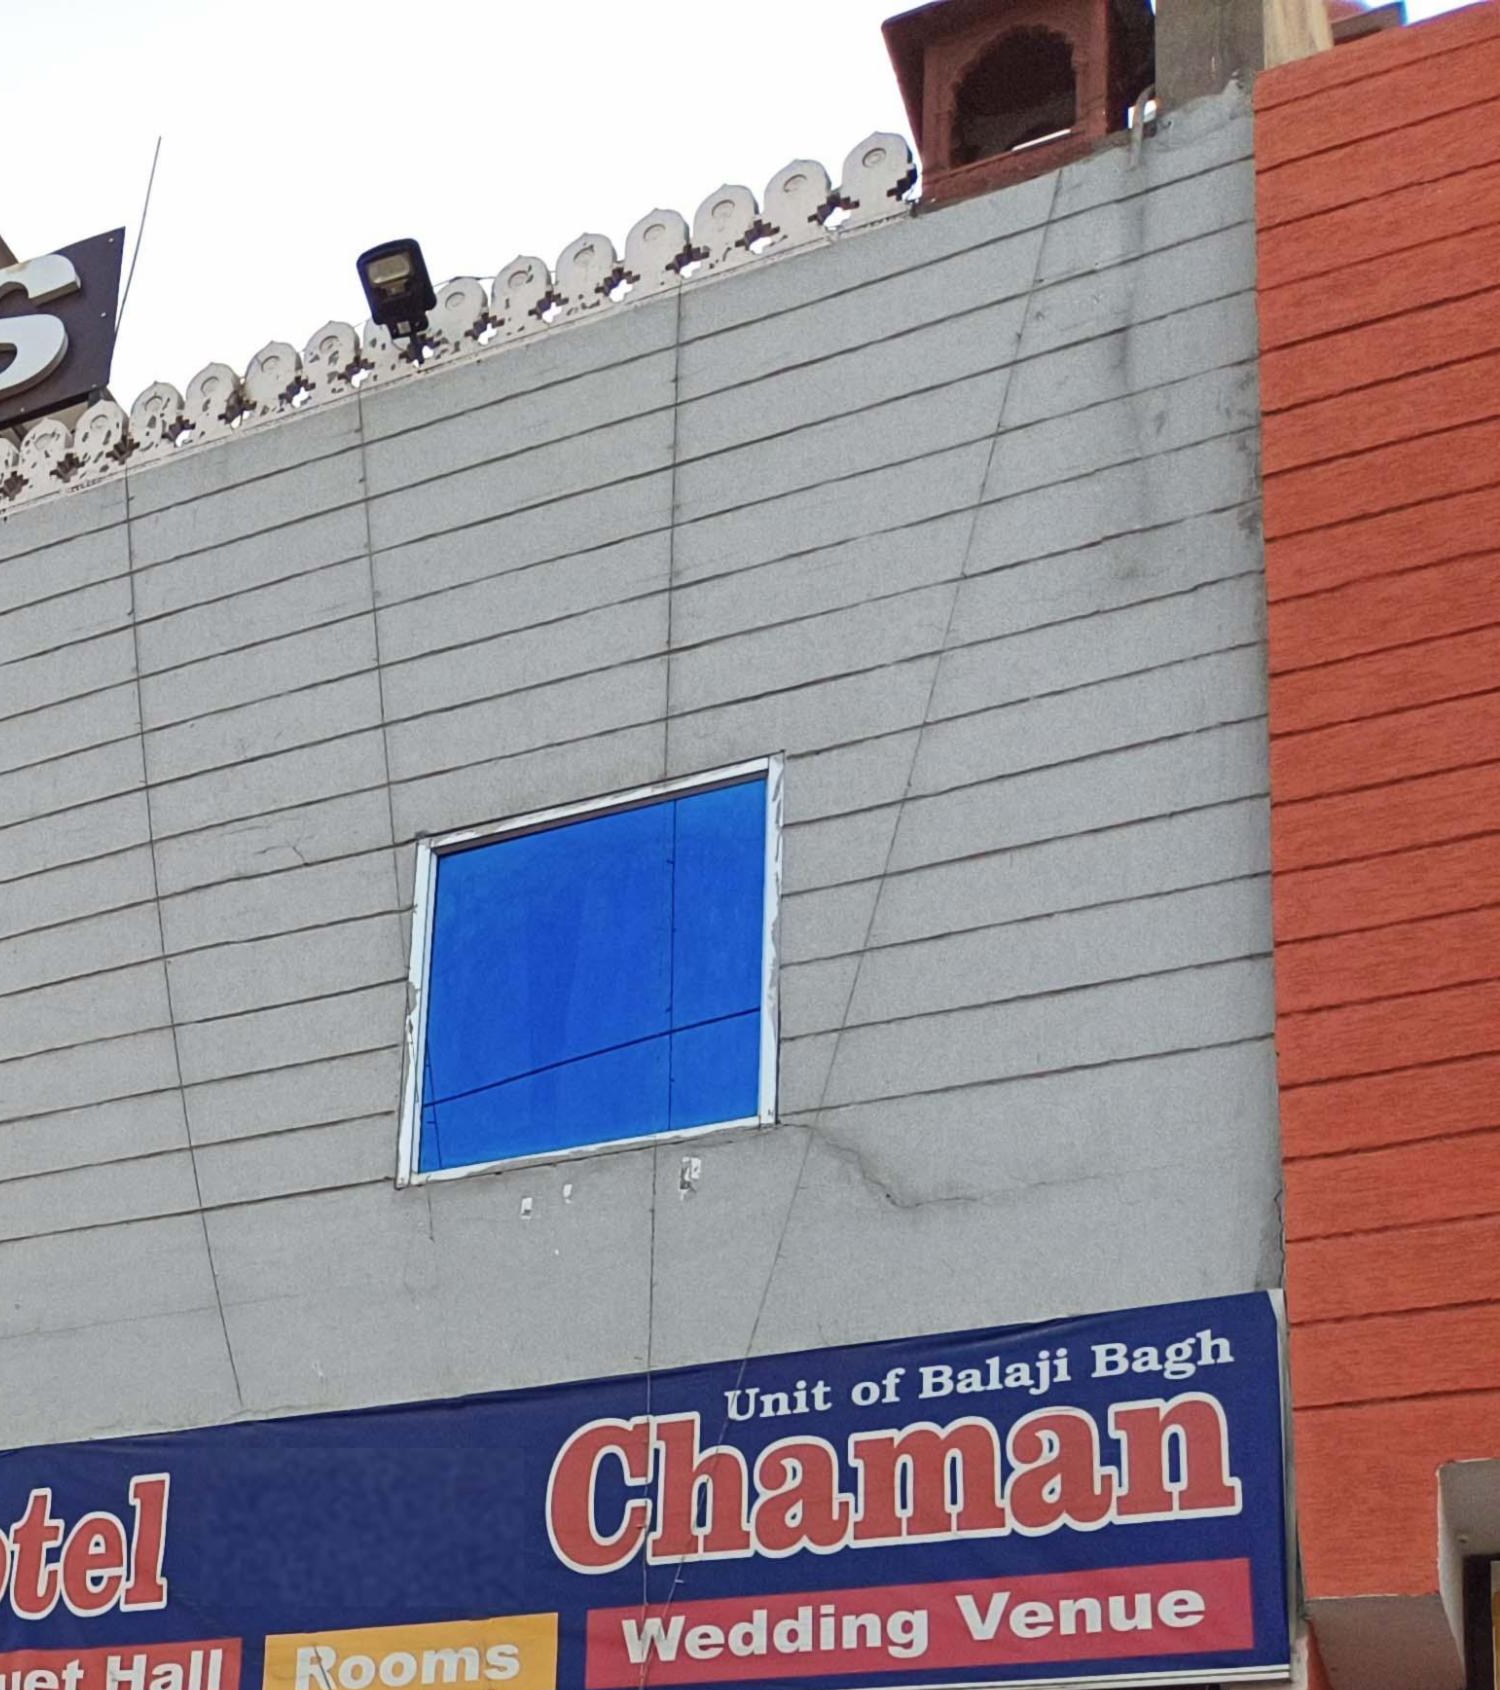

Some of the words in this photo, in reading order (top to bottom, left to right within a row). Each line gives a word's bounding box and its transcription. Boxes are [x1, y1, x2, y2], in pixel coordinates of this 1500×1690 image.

[725, 1379, 832, 1423] Unit
[851, 1365, 904, 1407] of
[918, 1346, 1072, 1398] Balaji
[1091, 1330, 1235, 1383] Bagh
[546, 1391, 1242, 1575] Chaman
[621, 1601, 930, 1670] Wedding
[956, 1583, 1206, 1645] Venue
